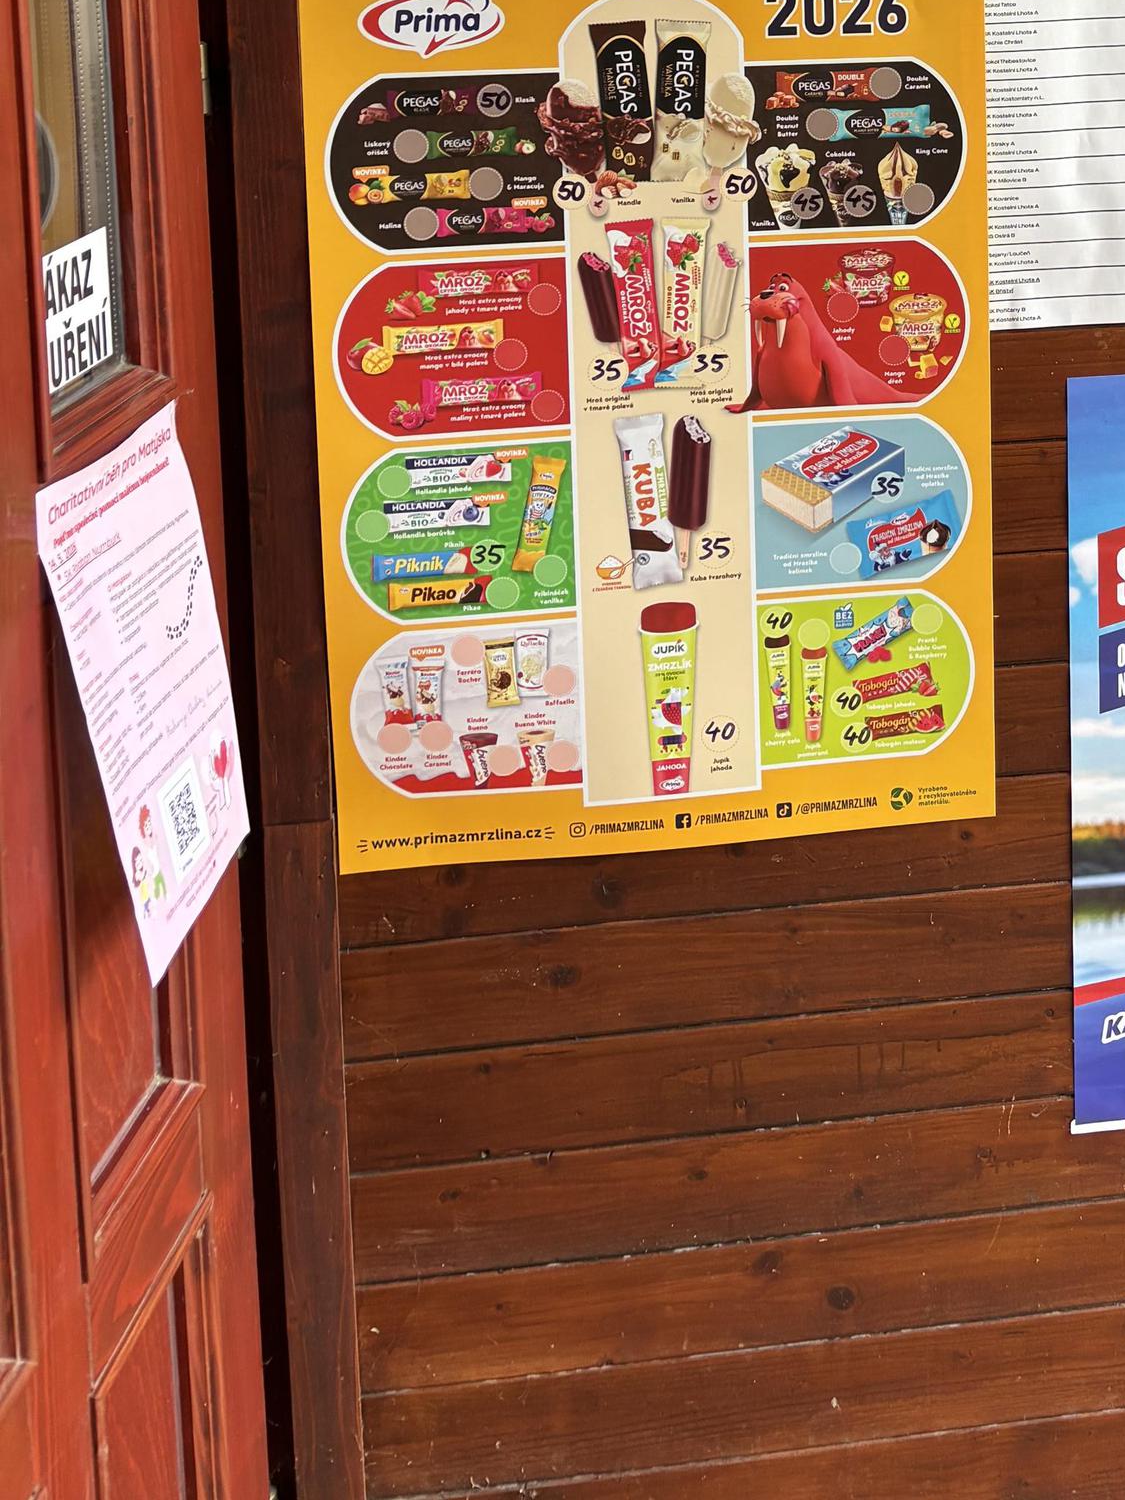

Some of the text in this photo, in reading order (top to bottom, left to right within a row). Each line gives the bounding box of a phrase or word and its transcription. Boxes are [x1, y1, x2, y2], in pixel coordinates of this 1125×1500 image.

[394, 8, 481, 35] Prima
[403, 97, 439, 107] PEGAS
[480, 91, 510, 110] 50
[44, 248, 94, 319] ÁKAZ
[625, 274, 653, 337] MROŽ
[49, 296, 108, 388] UŘENÍ
[592, 359, 624, 382] 35
[48, 427, 171, 525] Charitativní běh pro Matýska
[631, 462, 657, 527] KUBA
[699, 537, 731, 561] 35
[394, 556, 444, 574] Piknik
[411, 587, 457, 602] Pikao
[1117, 643, 1125, 667] O
[705, 721, 735, 743] 40
[656, 763, 687, 771] JAHODA
[590, 796, 878, 835] /PRIMAZMRZLINA /@PRIMAZMRZLINA
[371, 825, 543, 849] www.primazmrzlina.cz
